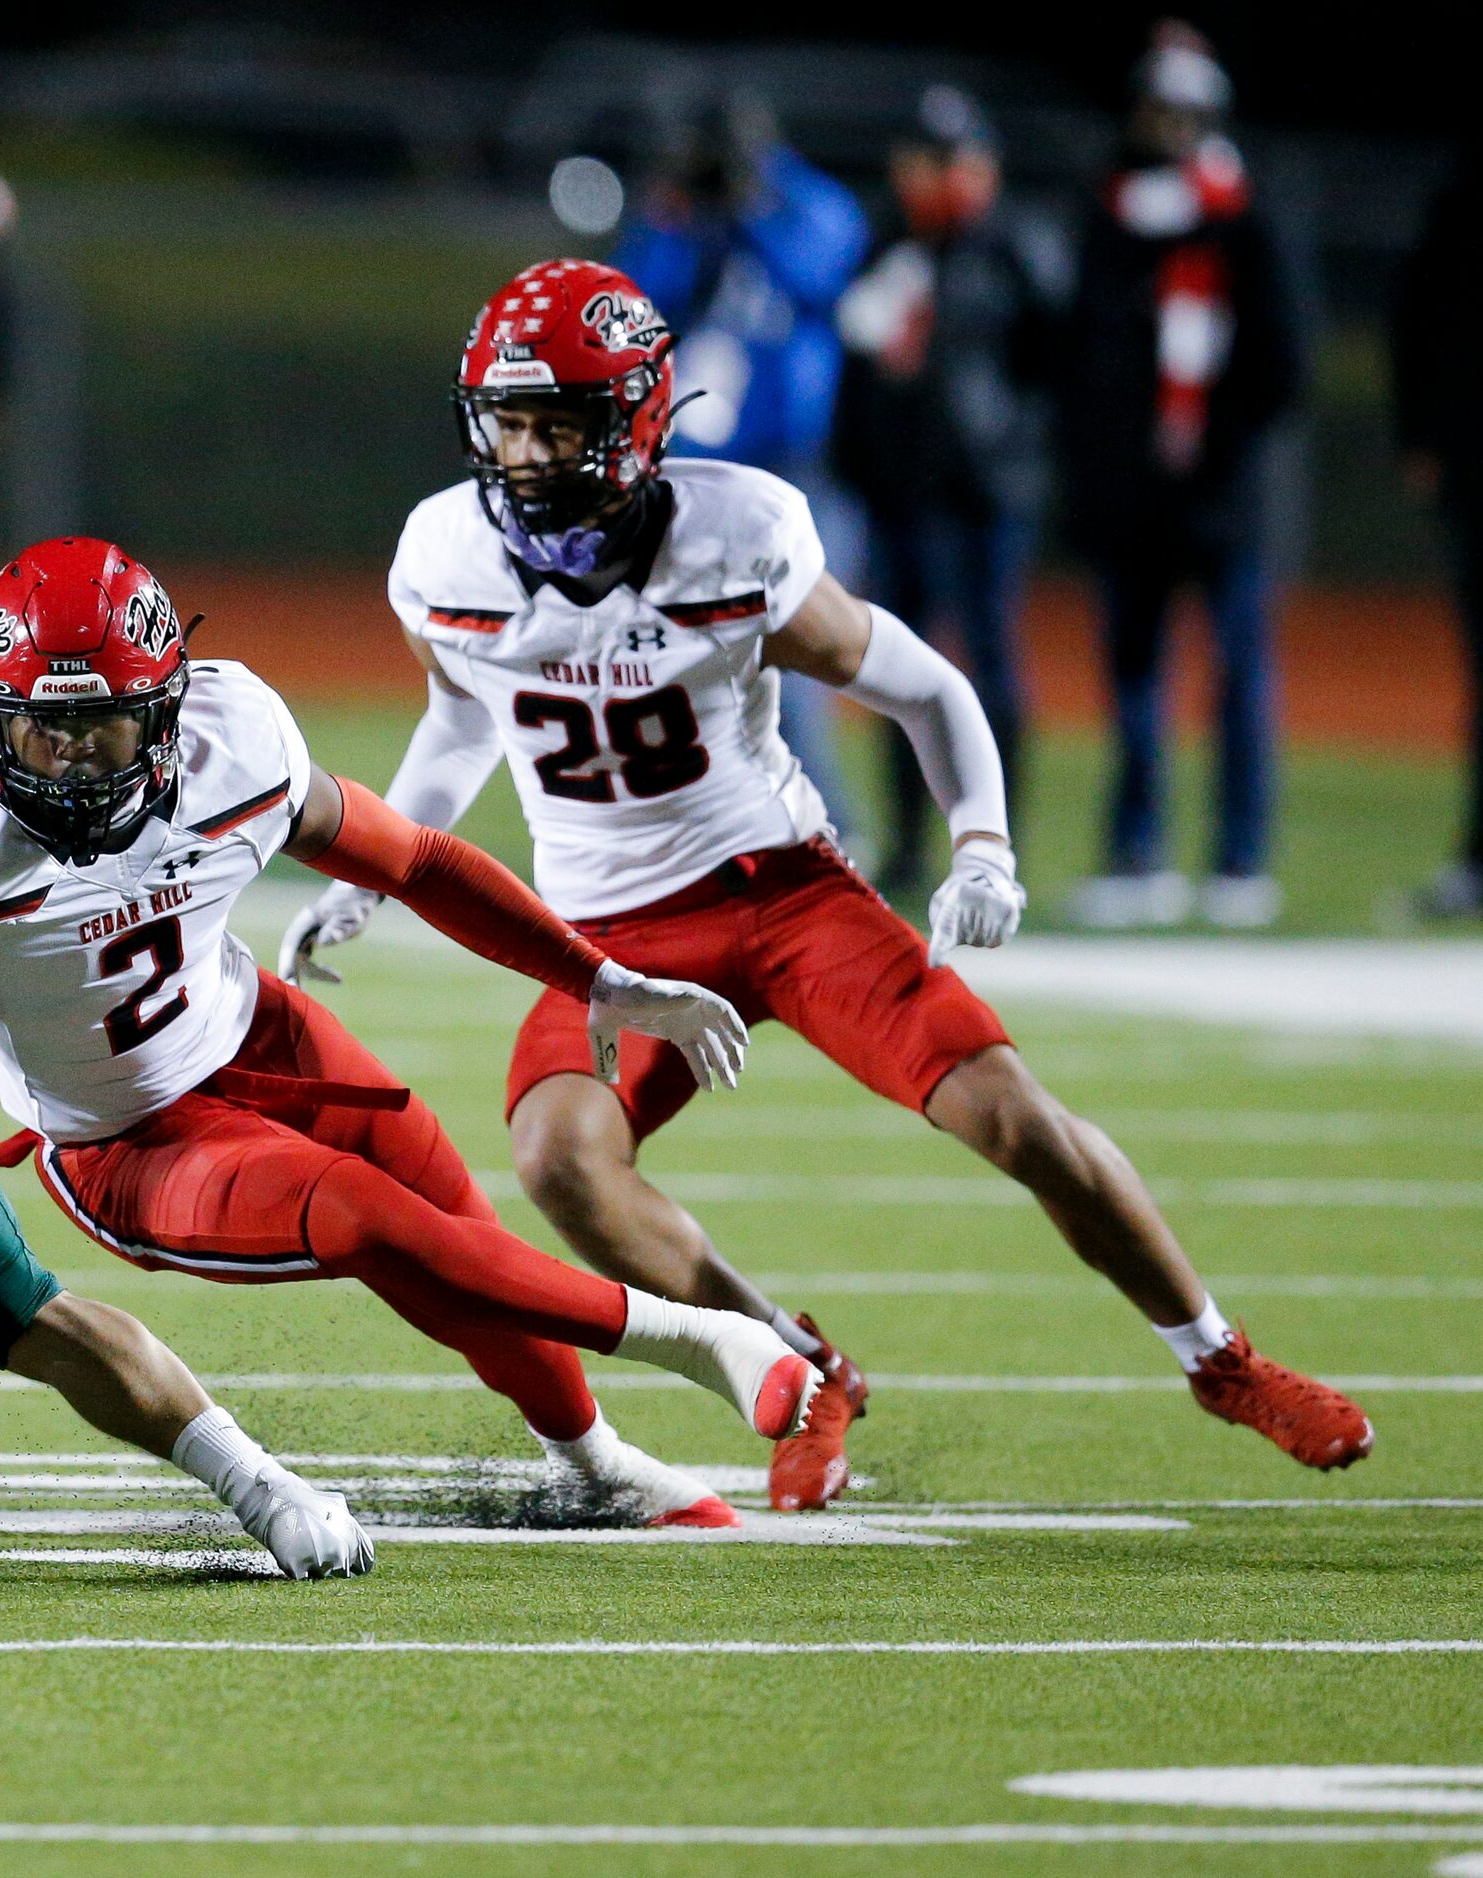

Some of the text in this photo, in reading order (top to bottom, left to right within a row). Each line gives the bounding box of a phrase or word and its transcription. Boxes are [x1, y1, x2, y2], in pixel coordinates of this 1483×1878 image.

[42, 680, 99, 694] Riddell
[50, 660, 90, 672] TTHL
[540, 661, 654, 687] CEDAR HILL
[513, 683, 710, 803] 28
[78, 880, 193, 945] CEDAR HILL
[99, 914, 190, 1057] 2
